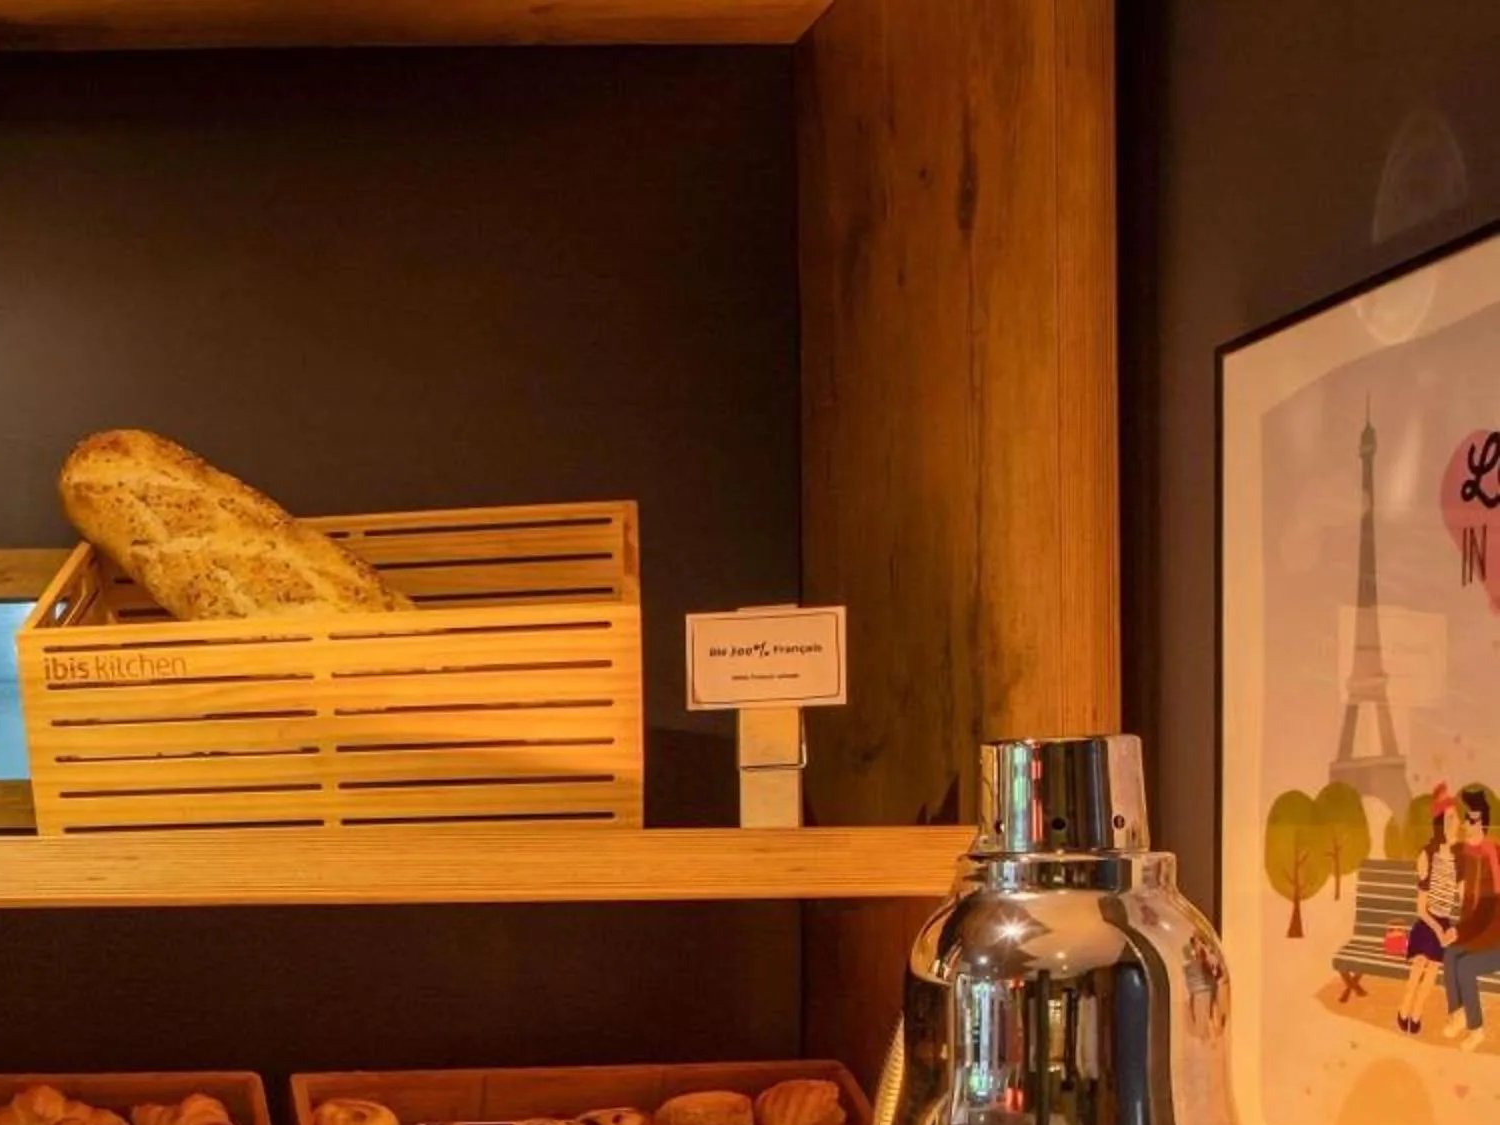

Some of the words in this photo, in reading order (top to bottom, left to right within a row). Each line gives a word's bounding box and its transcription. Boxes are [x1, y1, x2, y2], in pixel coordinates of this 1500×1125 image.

[1460, 431, 1500, 509] L
[1461, 524, 1488, 587] IN
[43, 657, 90, 681] ibis
[94, 653, 187, 680] kitchen
